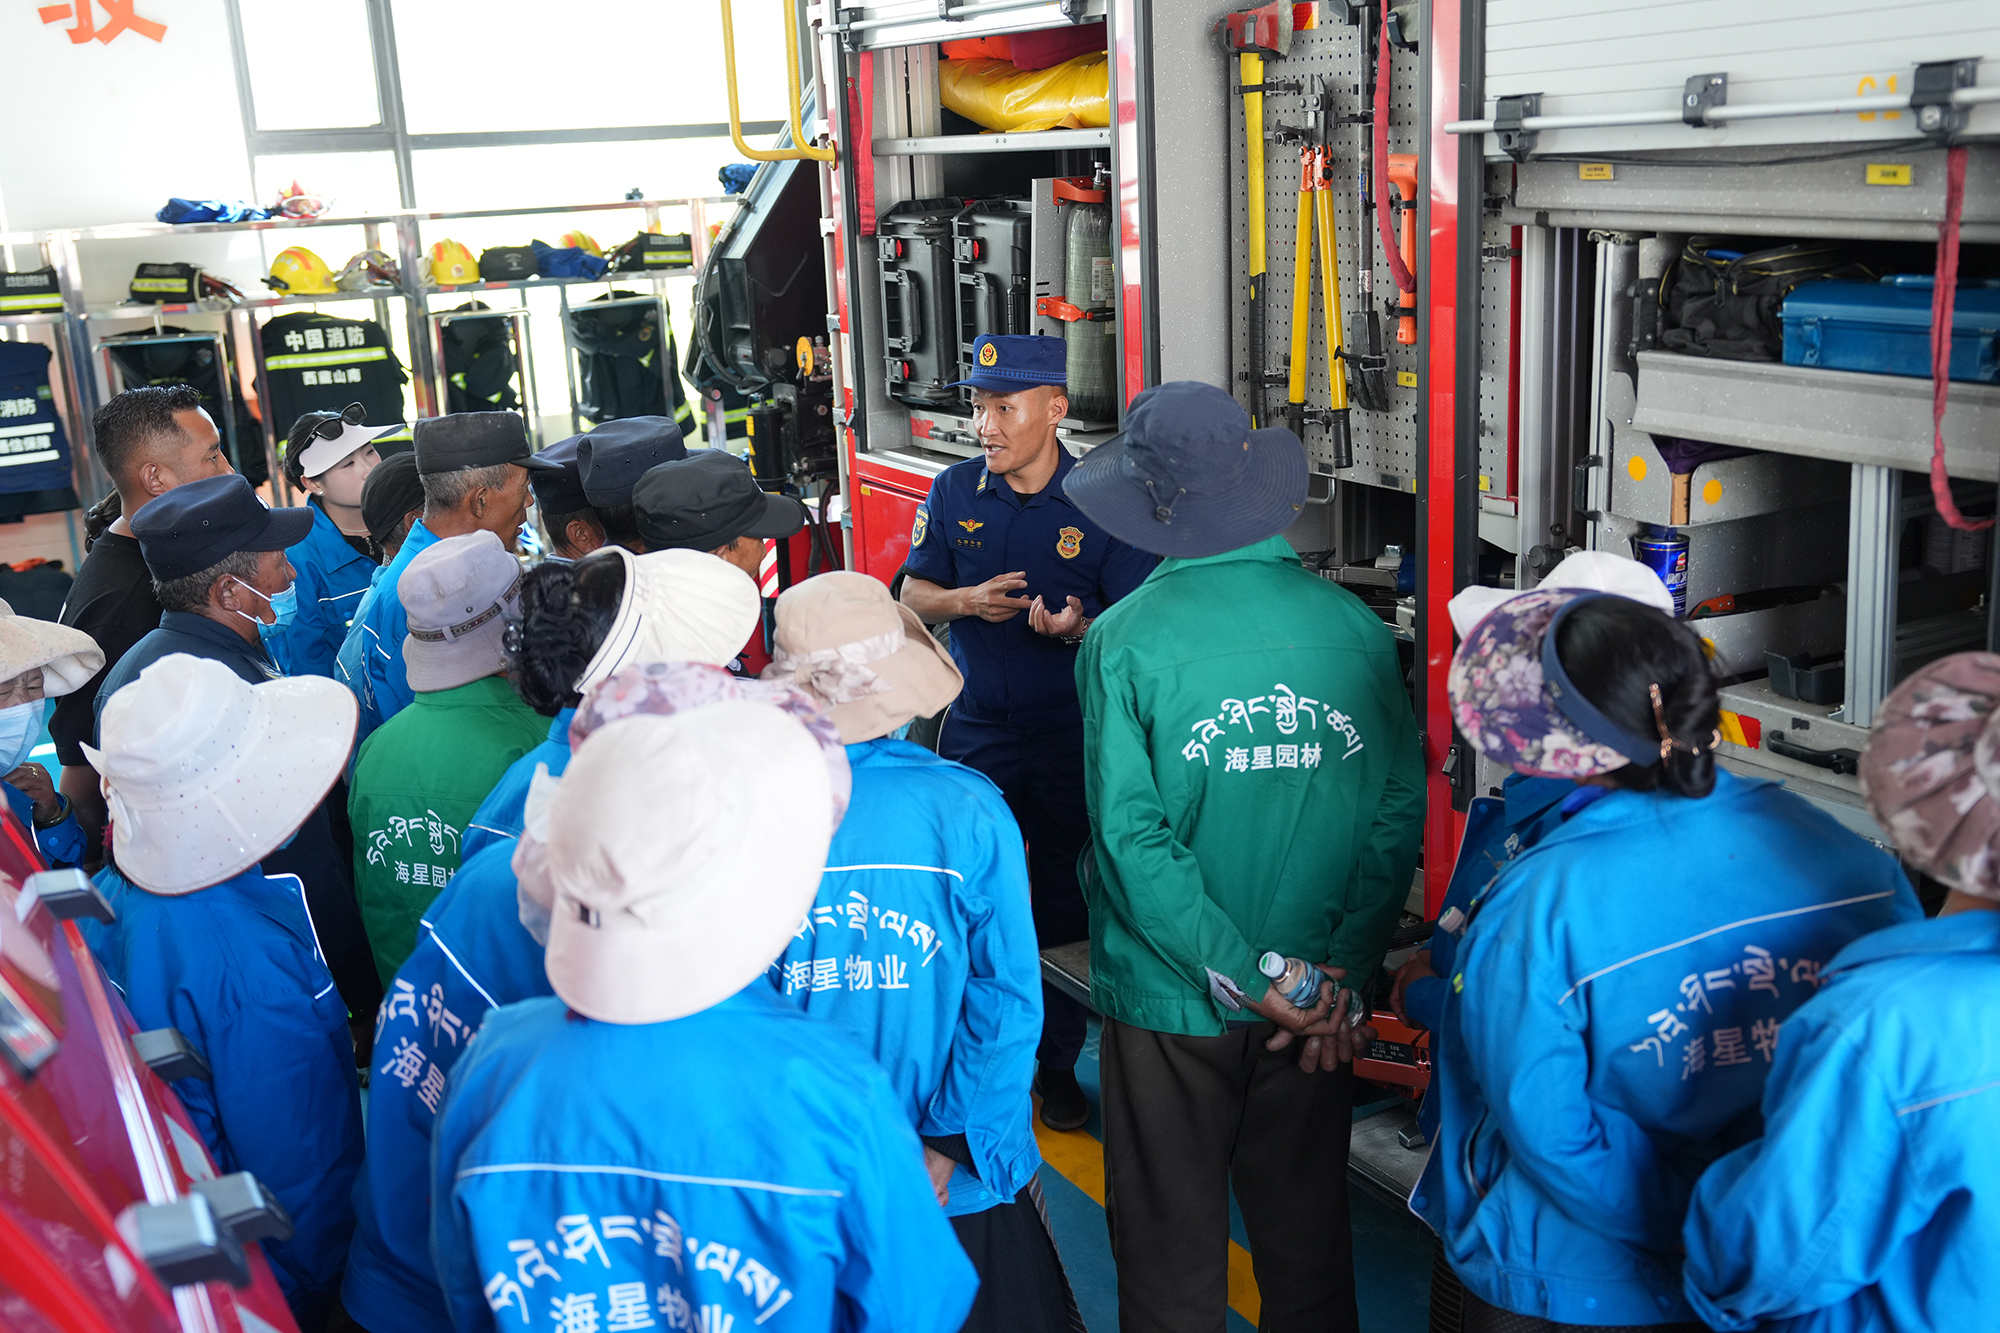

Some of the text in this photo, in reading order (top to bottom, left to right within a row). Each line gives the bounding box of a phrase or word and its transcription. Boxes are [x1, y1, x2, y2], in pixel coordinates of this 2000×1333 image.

[284, 325, 365, 353] 中国消防
[1224, 742, 1323, 773] 海星园林
[783, 954, 910, 995] 海星物业
